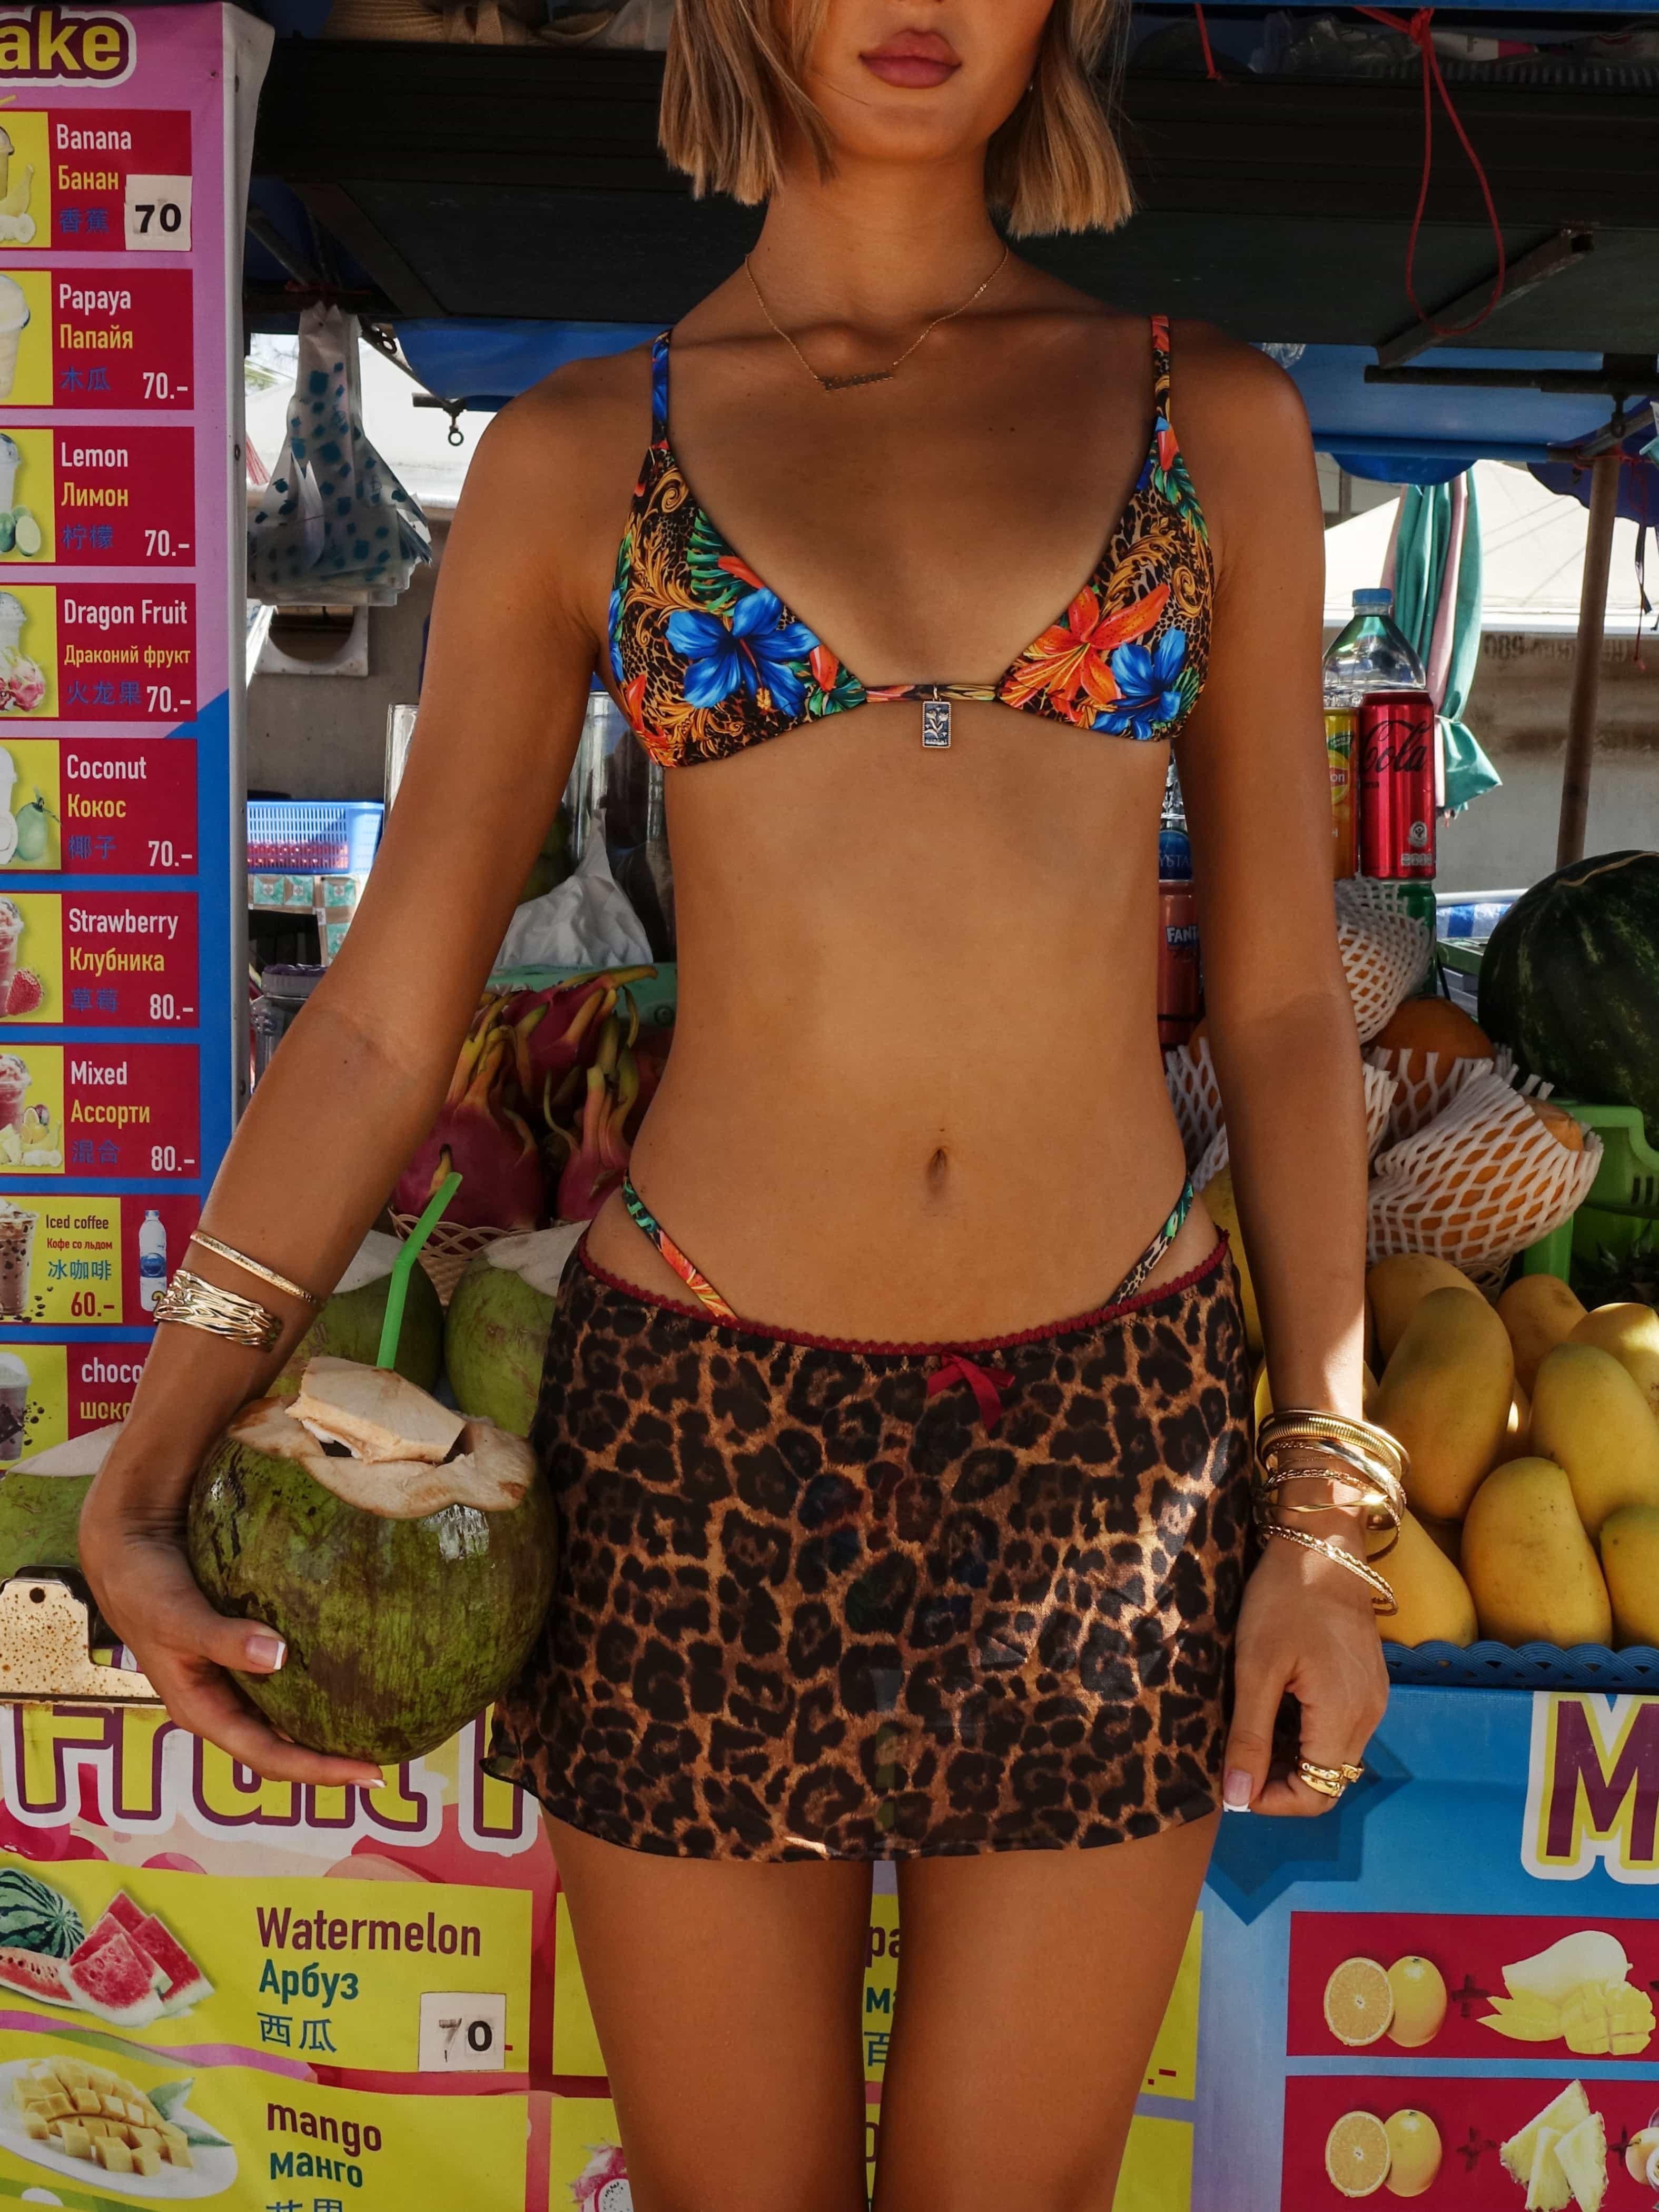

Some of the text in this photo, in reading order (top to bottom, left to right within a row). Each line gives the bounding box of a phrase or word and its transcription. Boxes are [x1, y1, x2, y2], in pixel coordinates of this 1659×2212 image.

[0, 11, 121, 71] ake
[57, 124, 131, 150] Banana
[59, 165, 118, 190] Банан
[59, 208, 108, 233] 香蕉
[135, 204, 181, 233] 70
[60, 284, 131, 315] Papaya
[61, 324, 132, 348] Папайя
[61, 366, 110, 391] 木瓜
[143, 372, 187, 399] 70.-
[62, 442, 127, 467] Lemon
[62, 482, 127, 506] Лимон
[62, 524, 113, 549] 柠檬
[145, 530, 190, 556] 70.-
[65, 599, 187, 630] Dragon Fruit
[64, 645, 190, 668] Драконий фрукт
[67, 680, 141, 705] 火龙果
[147, 686, 191, 712] 70.-
[67, 755, 146, 779] Coconut
[68, 794, 126, 817] Кокос
[67, 835, 116, 860] 椰子
[149, 841, 192, 866] 70.-
[70, 908, 178, 939] Strawberry
[71, 947, 164, 976] Клубника
[70, 987, 118, 1013] 草莓
[150, 994, 193, 1020] 80.-
[72, 1061, 126, 1084] Mixed
[71, 1100, 150, 1129] Ассорти
[71, 1139, 120, 1164] 混合
[152, 1146, 194, 1171] 80.-
[46, 1214, 108, 1229] Iced coffee
[47, 1238, 70, 1251] Кофе
[84, 1241, 112, 1250] льдом
[48, 1260, 112, 1281] 冰咖啡
[71, 1292, 114, 1317] 60.-
[82, 1357, 147, 1383] choco
[256, 1907, 480, 1957] Watermelon
[259, 1959, 358, 2008] Арбуз
[256, 2012, 337, 2053] 西瓜
[267, 2103, 382, 2157] mango
[270, 2151, 363, 2188] манго
